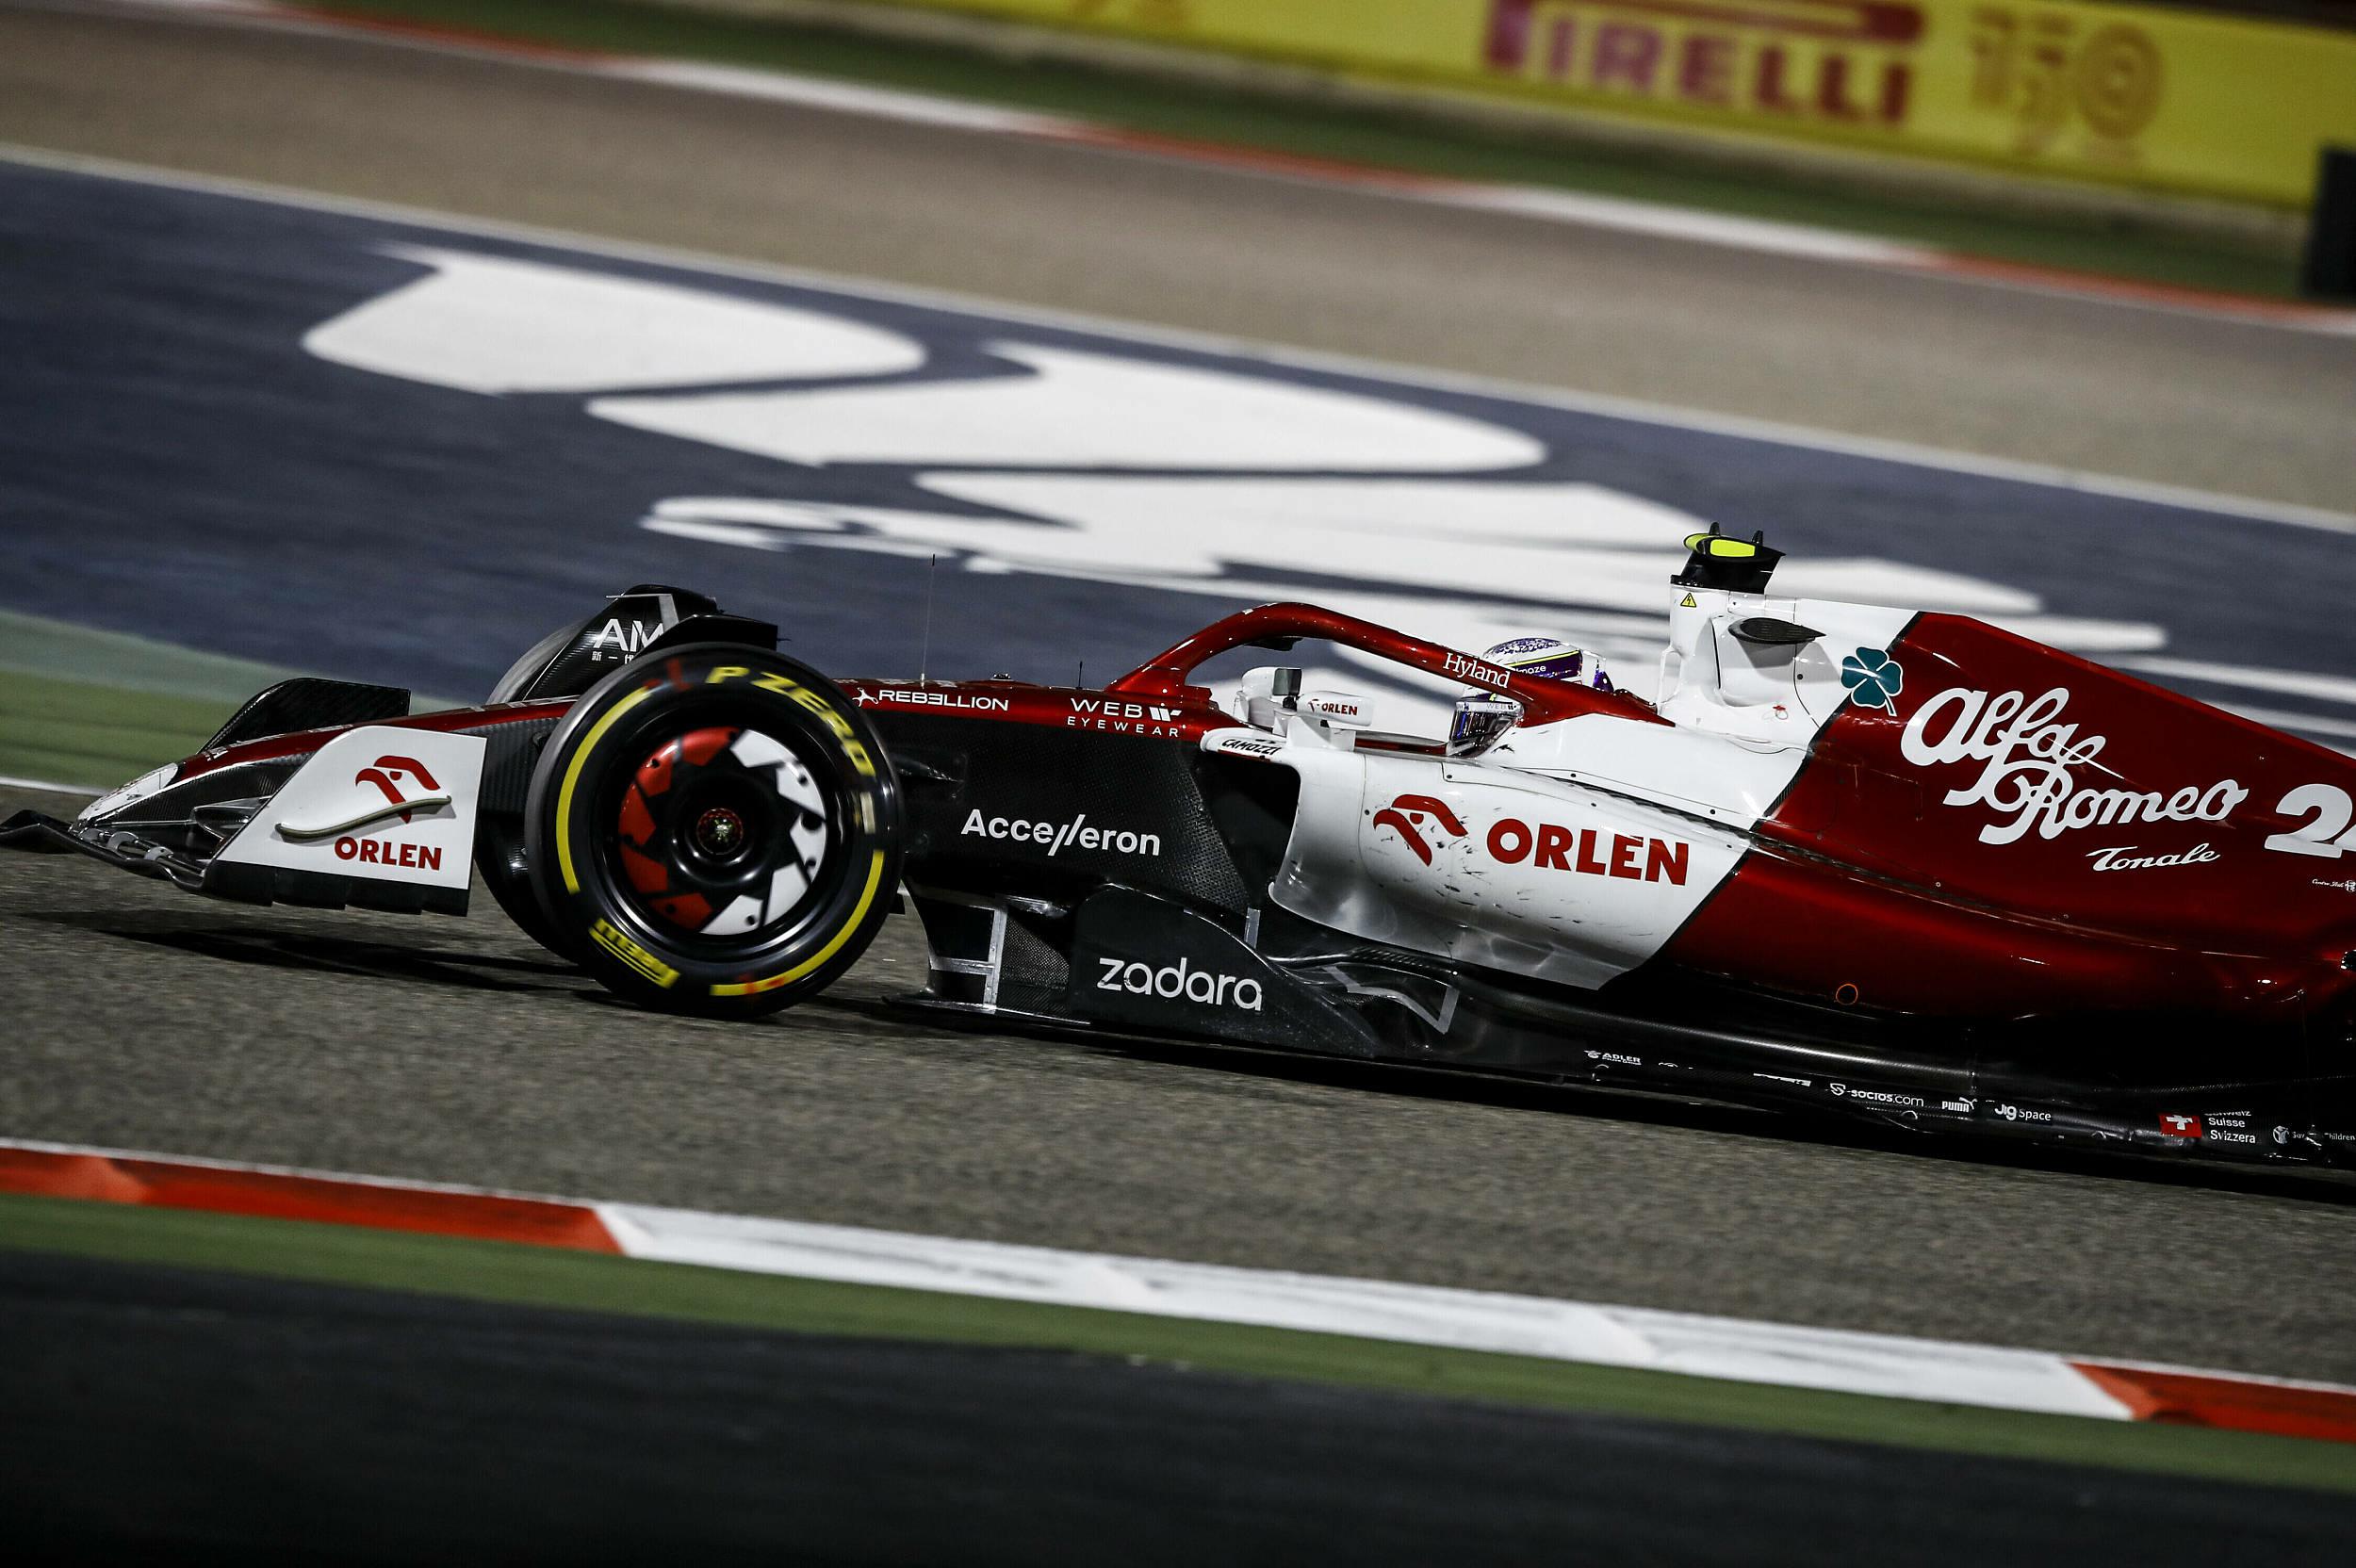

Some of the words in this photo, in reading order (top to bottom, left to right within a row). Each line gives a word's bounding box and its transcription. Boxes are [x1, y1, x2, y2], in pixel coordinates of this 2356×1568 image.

[1483, 0, 1927, 124] PIRELLI
[1443, 652, 1511, 689] Hyland
[878, 689, 1009, 711] REBELLION
[1070, 697, 1143, 718] WEB
[1321, 704, 1358, 716] ORLEN
[705, 666, 751, 684] P
[750, 672, 876, 776] ZERO
[1067, 716, 1178, 738] EYEWEAR
[1221, 739, 1283, 756] CAMOZZI
[1900, 686, 2106, 807] Alfa
[1978, 760, 2250, 845] Romeo
[334, 836, 443, 872] ORLEN
[1486, 818, 1690, 887] ORLEN
[2085, 842, 2221, 872] Tonale
[1096, 956, 1264, 1012] zadara
[1602, 1053, 1642, 1064] ADLER
[1850, 1089, 1924, 1107] socios.com
[1941, 1101, 1970, 1113] PUMA
[2019, 1108, 2052, 1121] Space
[2208, 1118, 2246, 1128] Suisse
[2210, 1129, 2256, 1144] Svizzera
